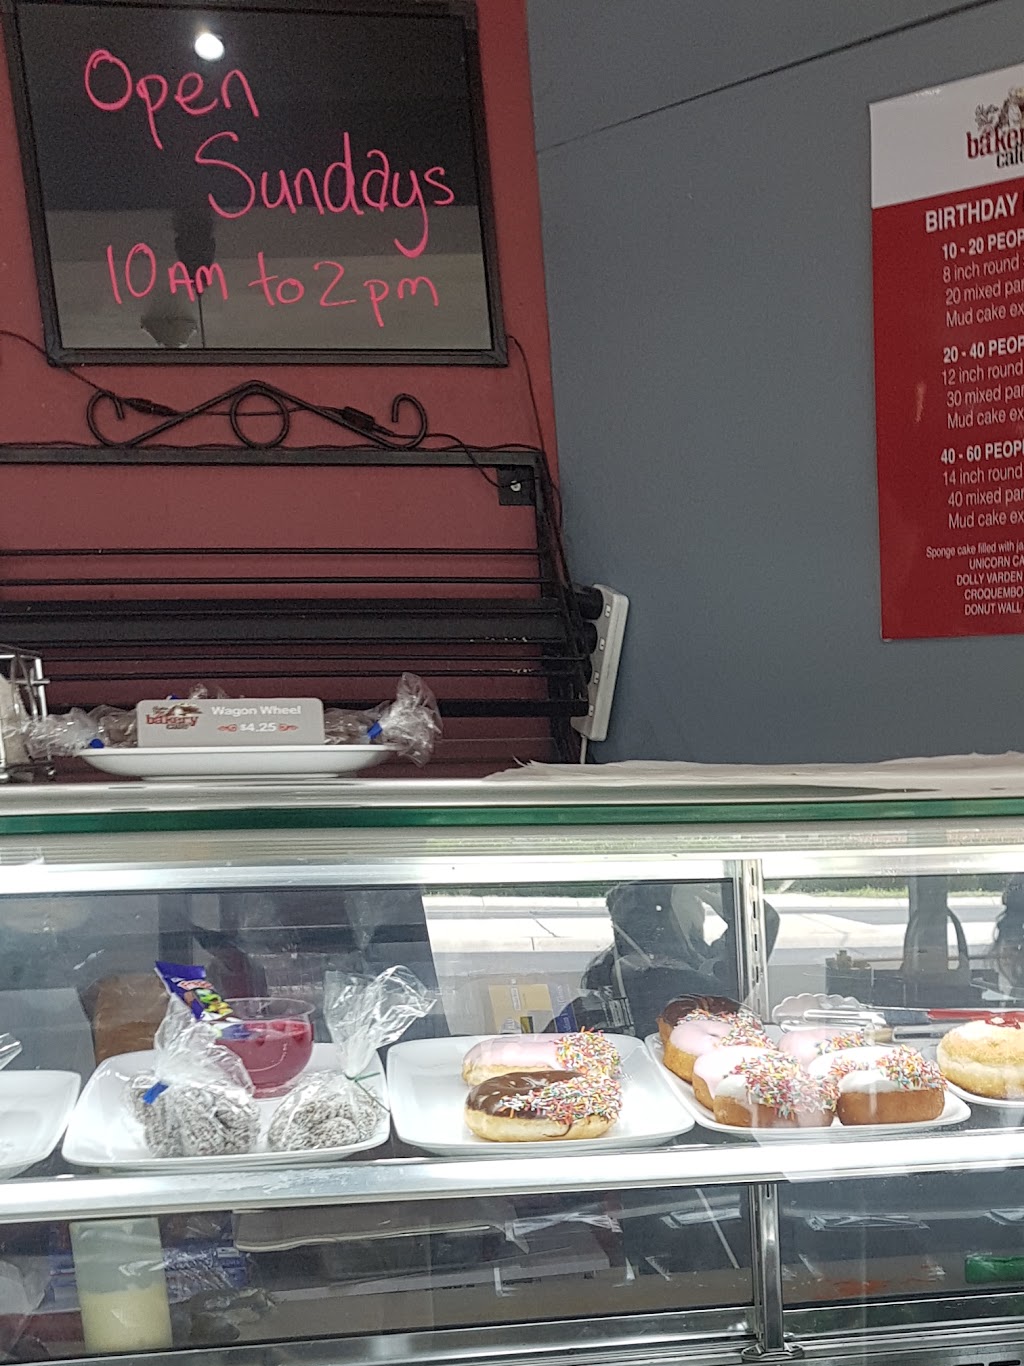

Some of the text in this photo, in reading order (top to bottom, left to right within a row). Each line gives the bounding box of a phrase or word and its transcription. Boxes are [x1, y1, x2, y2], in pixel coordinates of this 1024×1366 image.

[84, 48, 260, 150] Open
[194, 131, 456, 259] Sundays
[925, 193, 1018, 234] BIRTHDAY
[941, 243, 957, 261] 10
[968, 239, 984, 256] 20
[248, 252, 304, 306] to
[942, 266, 951, 284] 8
[953, 261, 980, 281] inch
[983, 254, 1020, 275] round
[945, 289, 961, 306] 20
[964, 283, 1001, 303] mixed
[946, 308, 973, 328] Mud
[976, 303, 1006, 324] cake
[943, 347, 959, 365] 20
[969, 343, 985, 360] 40
[942, 370, 956, 387] 12
[958, 364, 984, 385] inch
[988, 359, 1024, 379] round
[946, 391, 961, 408] 30
[964, 386, 1001, 405] mixed
[947, 412, 974, 430] Mud
[977, 408, 1006, 425] cake
[940, 449, 956, 465] 40
[966, 445, 982, 462] 60
[942, 469, 956, 486] 14
[959, 465, 985, 485] inch
[988, 462, 1023, 481] round
[948, 491, 963, 508] 40
[965, 487, 1001, 505] mixed
[948, 513, 975, 530] Mud
[977, 509, 1006, 527] cake
[926, 545, 956, 560] Sponge
[957, 543, 976, 557] cake
[976, 541, 997, 555] filled
[997, 540, 1015, 554] with
[969, 555, 1011, 570] UNICORN
[956, 572, 985, 587] DOLLY
[986, 570, 1023, 584] VARDEN
[964, 602, 995, 617] DONUT
[997, 601, 1022, 615] WALL
[211, 705, 302, 717] Wagon Wheel
[240, 722, 277, 732] $4.25
